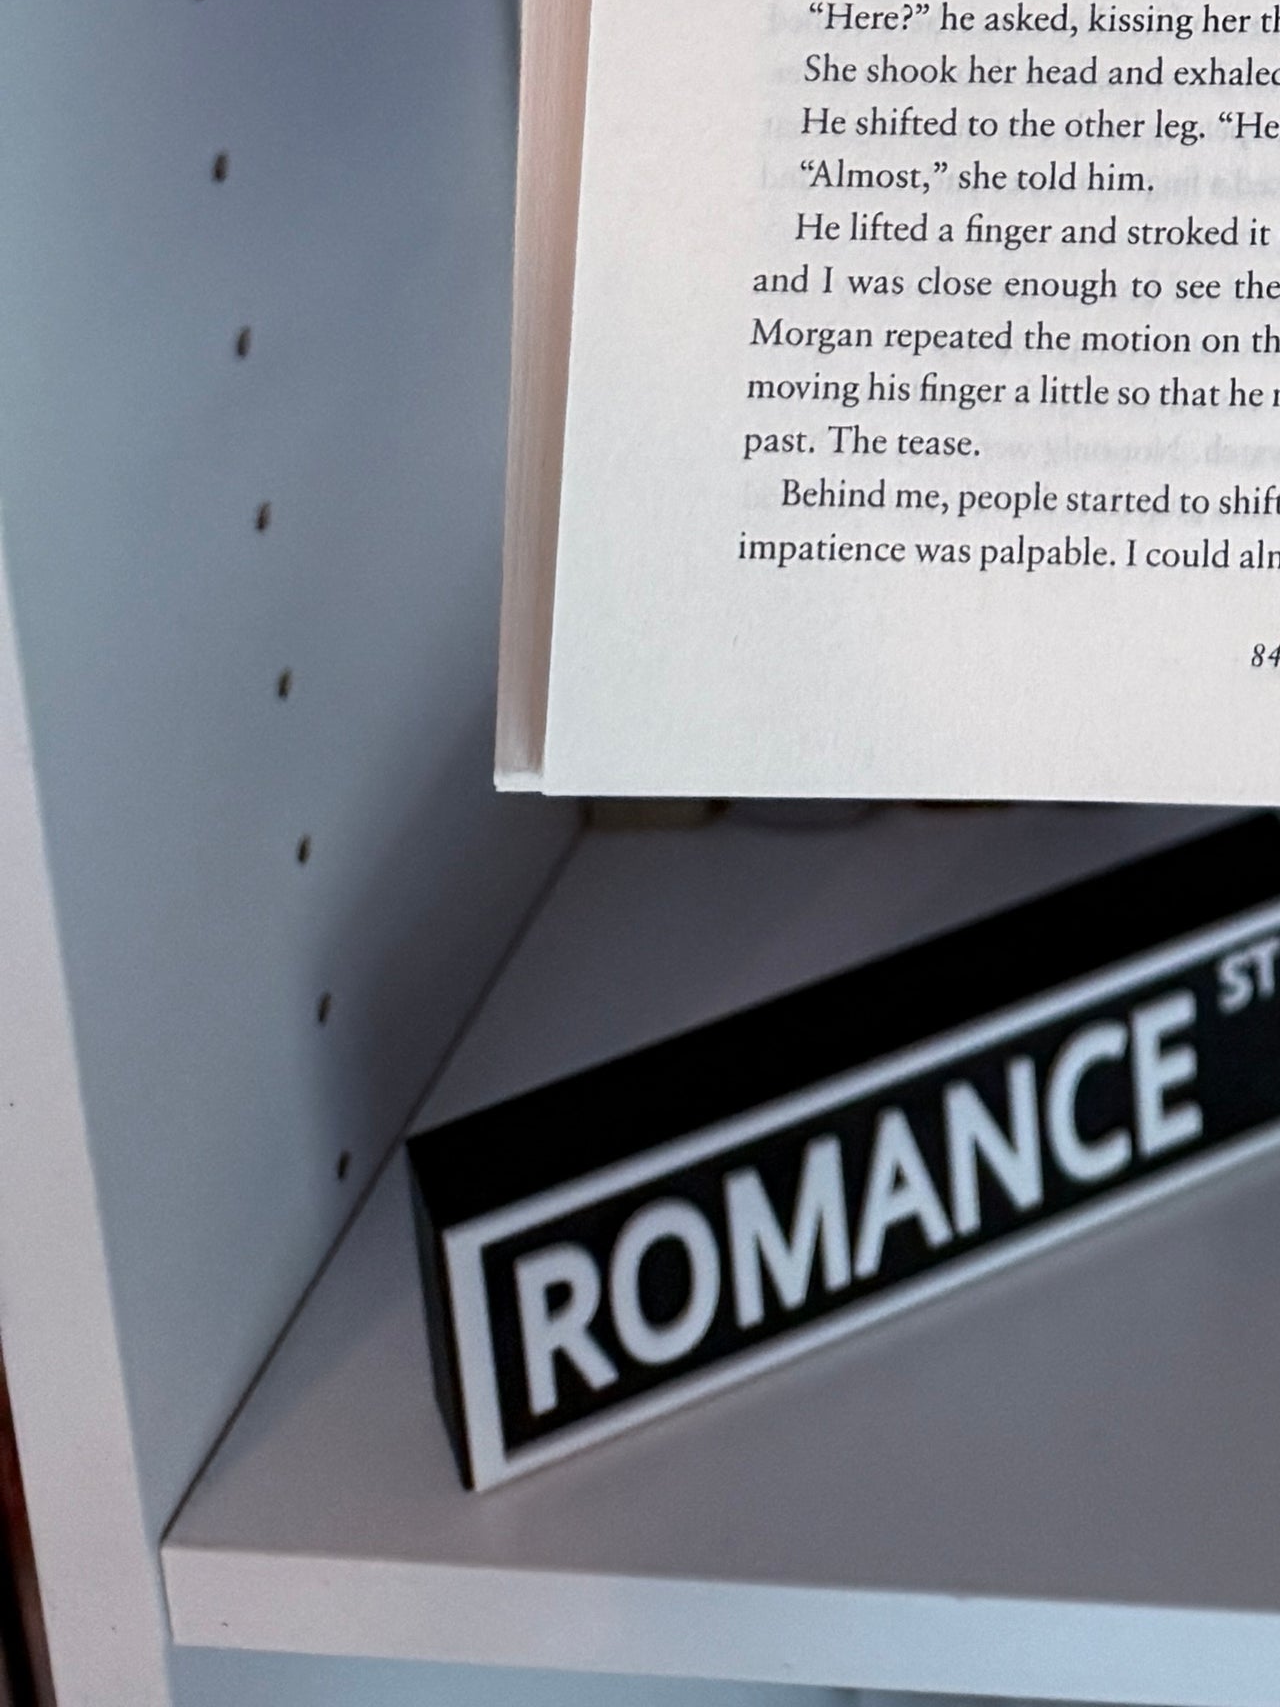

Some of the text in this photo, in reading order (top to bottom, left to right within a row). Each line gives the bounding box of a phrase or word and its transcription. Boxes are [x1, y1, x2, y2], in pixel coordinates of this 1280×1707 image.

[799, 157, 1155, 196] “Almost,” she told him.
[748, 316, 874, 356] Morgan
[883, 319, 1014, 358] repeated
[1023, 319, 1072, 352] the
[1080, 323, 1192, 354] motion
[1200, 333, 1241, 355] on
[780, 476, 887, 510] Behind
[894, 488, 950, 516] me,
[956, 479, 1059, 520] people
[1065, 482, 1171, 515] started
[1179, 492, 1211, 516] to
[737, 530, 907, 570] impatience
[913, 542, 972, 565] was
[978, 533, 1117, 574] palpable.
[1125, 538, 1138, 568] I
[1144, 537, 1231, 570] could
[511, 989, 1203, 1416] ROMANCE
